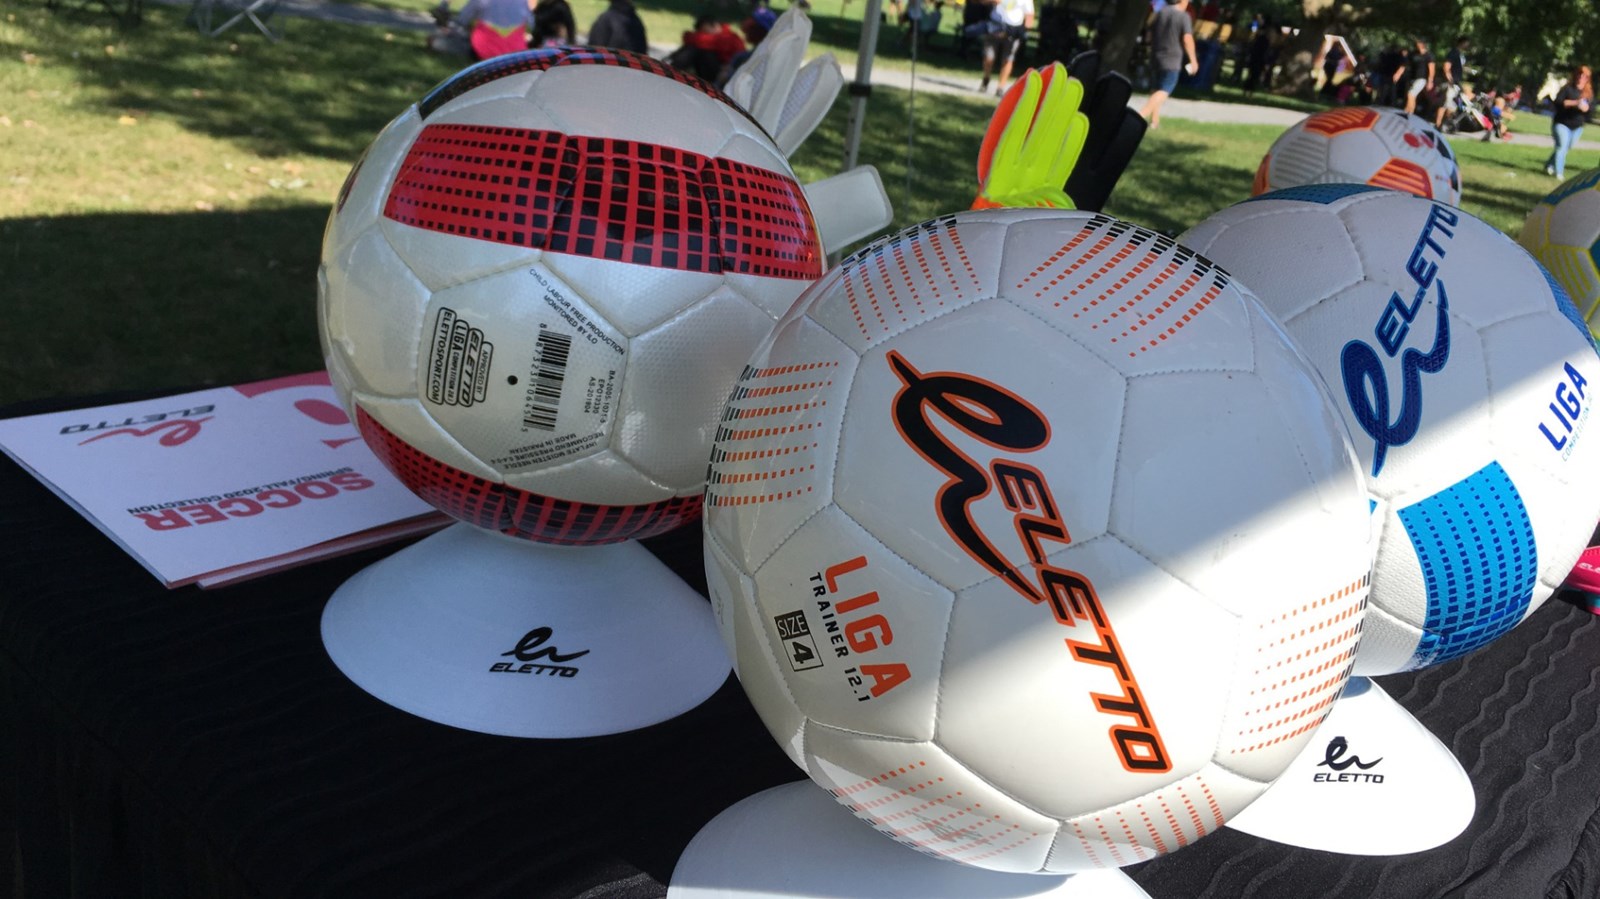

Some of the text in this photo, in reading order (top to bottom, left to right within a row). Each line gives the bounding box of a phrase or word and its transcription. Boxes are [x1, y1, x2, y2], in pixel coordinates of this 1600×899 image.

[1375, 204, 1458, 358] ELETTO
[530, 268, 625, 355] CHILD LABOUR FREE PRODUCTION
[544, 295, 578, 327] MONITORED
[577, 326, 588, 334] BY
[452, 325, 467, 351] LIGA
[432, 311, 453, 401] ELETTOSPORT.COM
[462, 331, 480, 405] ELETTO
[476, 349, 488, 394] APPROVED BY
[59, 404, 215, 435] ELETTO
[1538, 361, 1587, 451] LIGA
[509, 443, 545, 454] PAKISTAN
[555, 432, 604, 451] RECOMMEND
[556, 433, 577, 441] MADE
[504, 441, 598, 469] INFLATE MOISTEN NEEDLE
[516, 446, 555, 461] PRESSURE
[127, 494, 223, 515] COLLECTION
[134, 471, 375, 531] SOCCER
[222, 486, 261, 499] 2020
[777, 614, 808, 638] SIZE
[825, 555, 911, 698] LIGA
[989, 458, 1173, 774] ELETTO
[809, 572, 870, 702] TRAINER 12.1
[791, 641, 815, 665] 4
[489, 662, 579, 677] ELETTO
[1313, 773, 1384, 784] ELETTO
